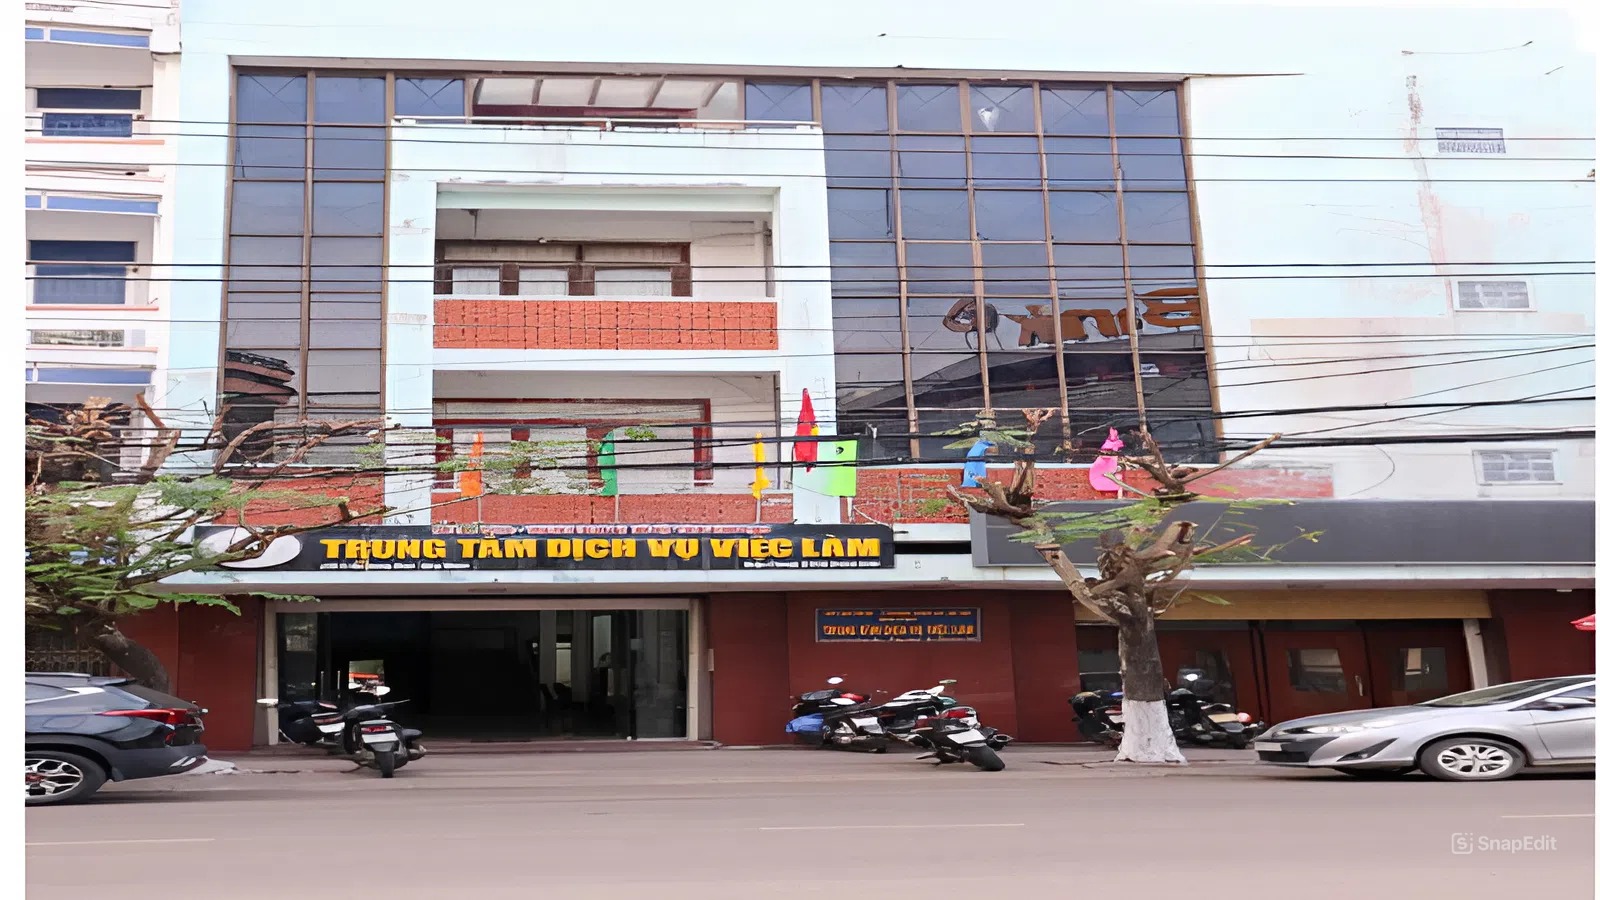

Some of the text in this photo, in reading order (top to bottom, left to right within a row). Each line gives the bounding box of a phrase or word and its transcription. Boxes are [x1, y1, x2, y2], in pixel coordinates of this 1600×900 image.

[320, 539, 446, 559] TRUNG
[547, 538, 637, 561] DỊCH
[647, 538, 699, 561] VỤ
[710, 535, 793, 560] VIỆC
[802, 534, 880, 557] LÀM
